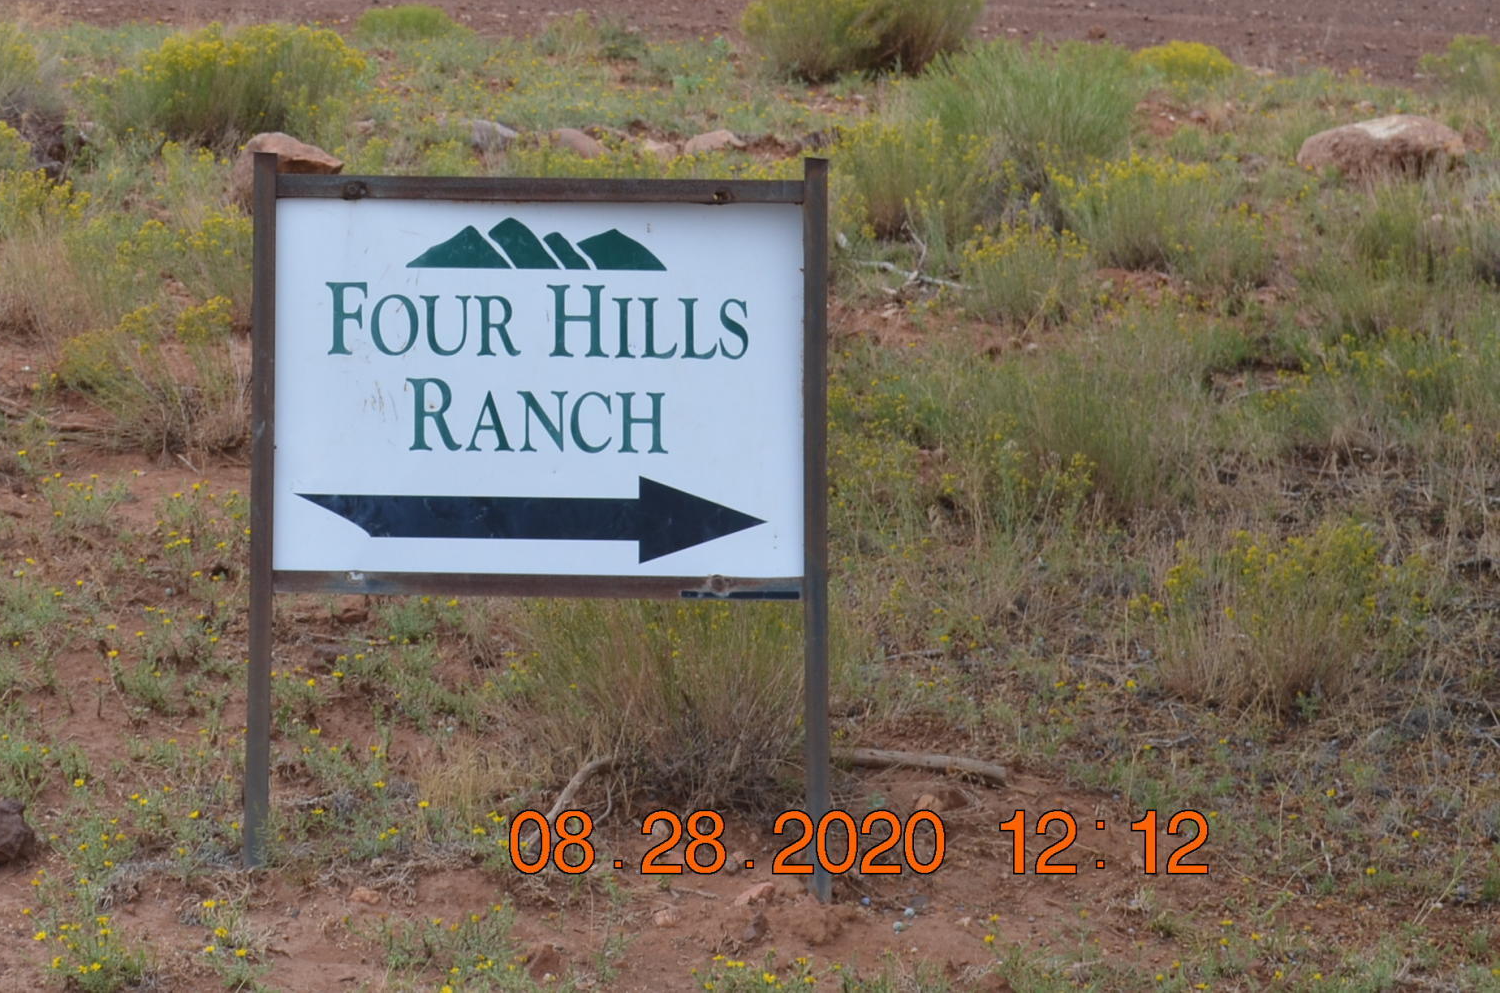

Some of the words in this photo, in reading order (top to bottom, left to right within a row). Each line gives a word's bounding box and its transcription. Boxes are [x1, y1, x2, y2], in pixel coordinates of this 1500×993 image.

[325, 281, 522, 357] FOUR
[546, 283, 750, 361] HILLS
[405, 376, 669, 455] RANCH
